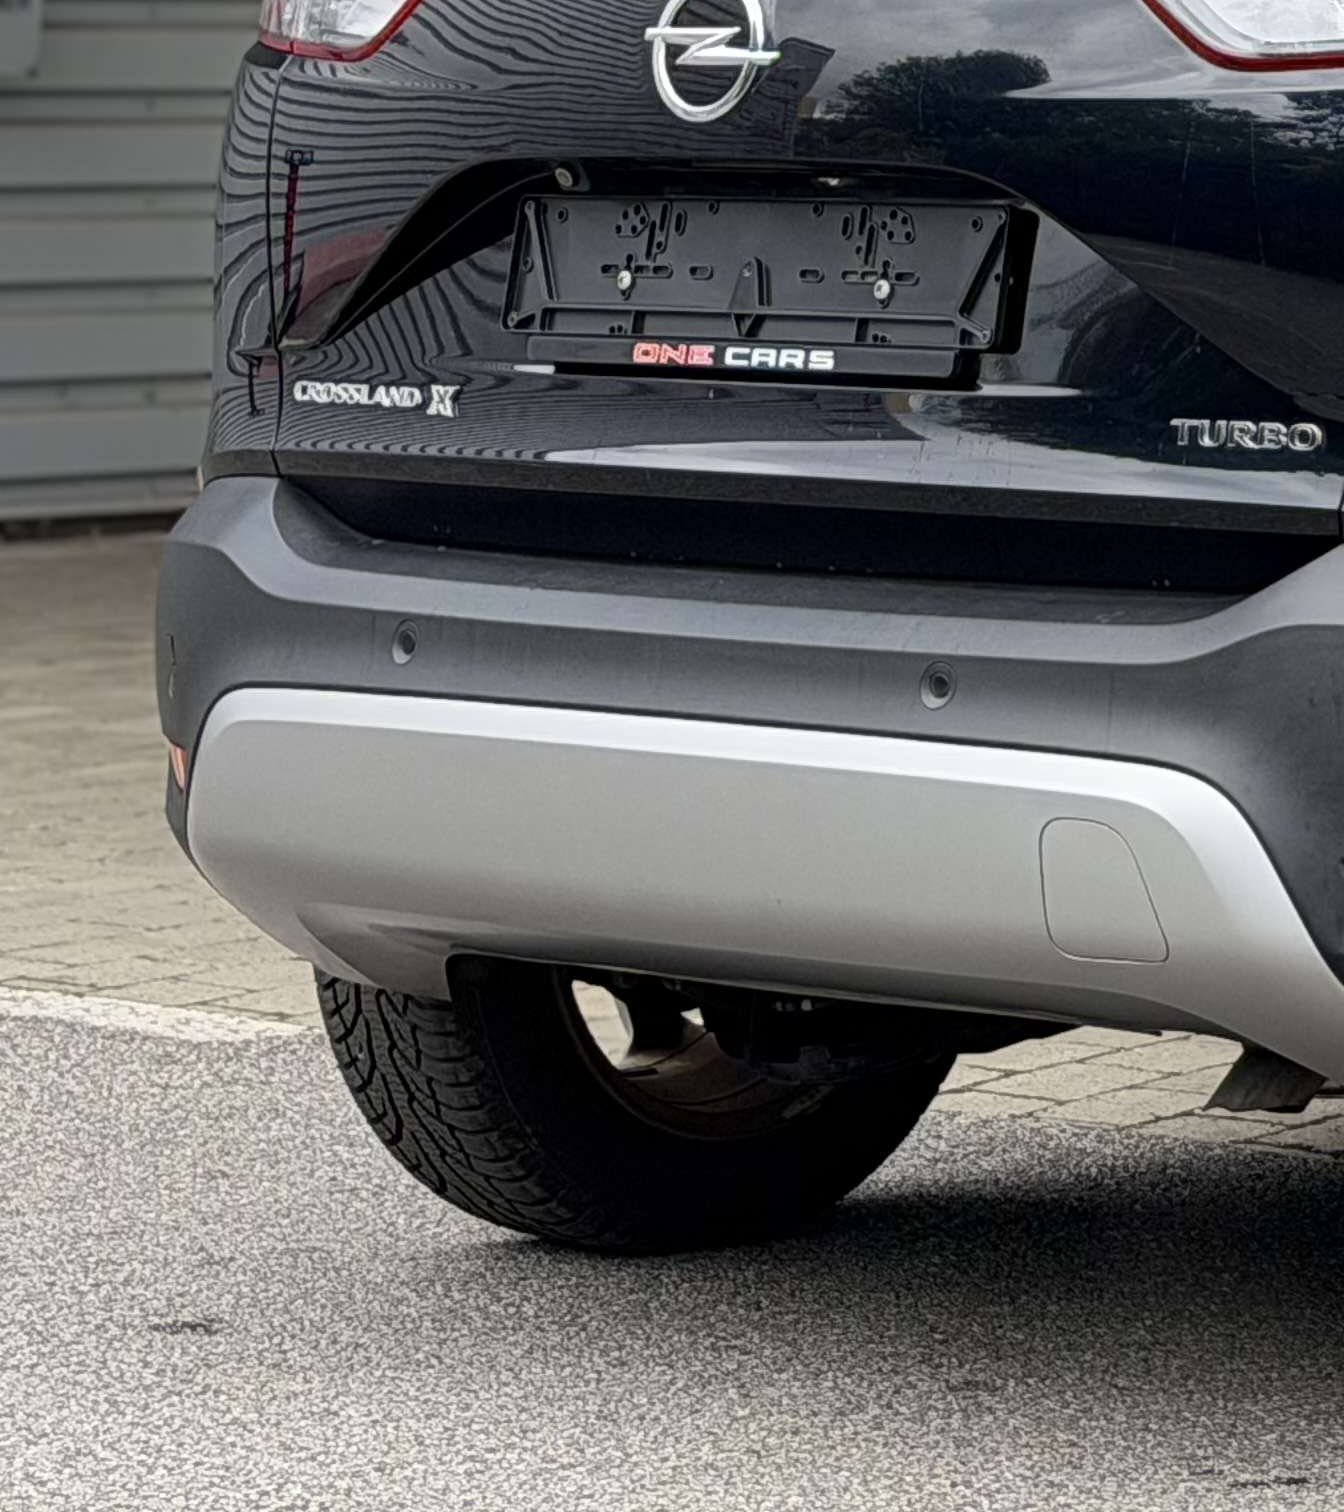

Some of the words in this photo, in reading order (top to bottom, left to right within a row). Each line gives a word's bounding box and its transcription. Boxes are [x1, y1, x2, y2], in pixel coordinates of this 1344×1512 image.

[633, 342, 715, 366] ONE
[724, 346, 835, 370] CARS
[293, 380, 422, 407] CROSSLAND
[426, 384, 460, 418] X
[1169, 418, 1322, 451] TURBO
